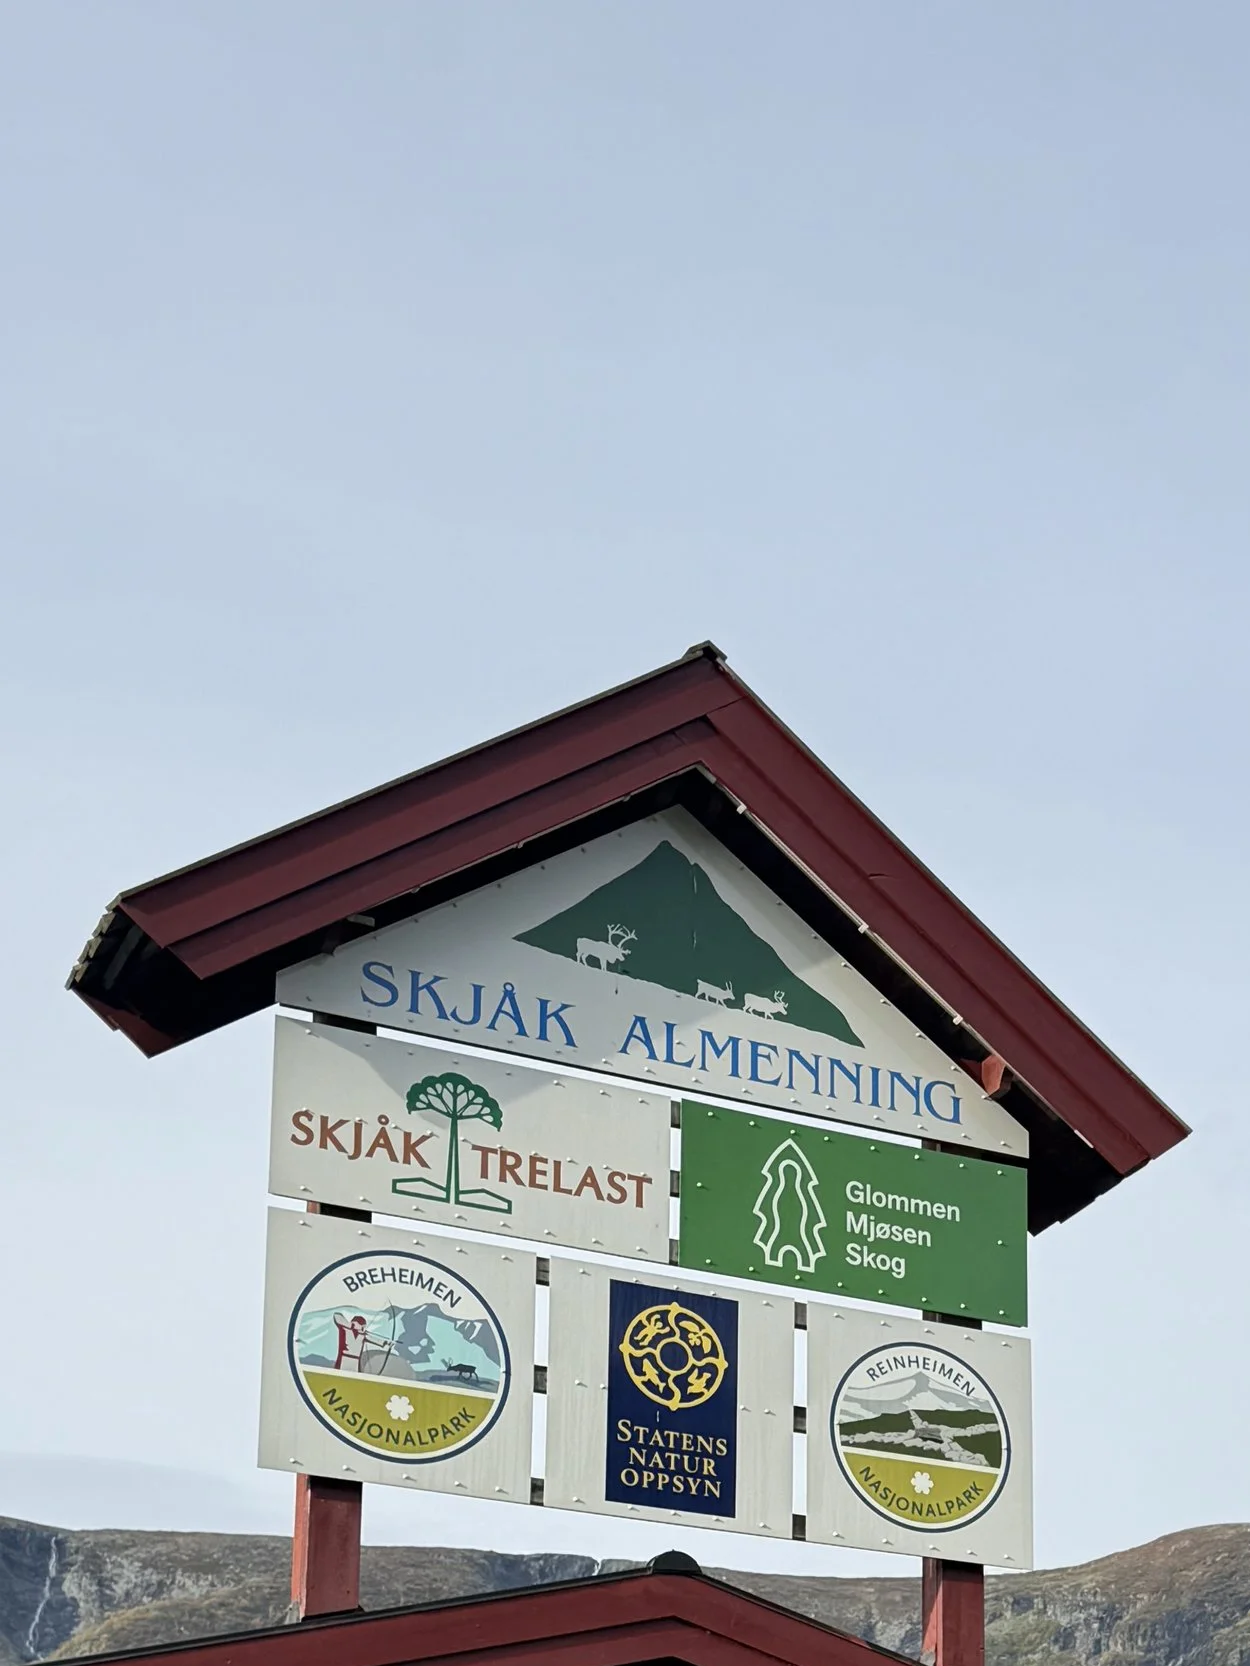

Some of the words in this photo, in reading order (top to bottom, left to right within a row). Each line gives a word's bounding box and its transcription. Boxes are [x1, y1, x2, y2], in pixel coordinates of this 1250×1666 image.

[360, 960, 578, 1048] SKJÅK
[617, 1015, 963, 1126] ALMENNING
[290, 1109, 432, 1168] SKJÅK
[471, 1145, 653, 1209] TRELAST
[845, 1180, 961, 1223] Glommen
[845, 1213, 932, 1248] Mjøsen
[845, 1242, 906, 1279] Skog
[343, 1266, 462, 1309] BREHEIMEN
[866, 1355, 976, 1397] REINHEIMEN
[322, 1387, 476, 1447] NASJONALPARK
[616, 1418, 728, 1457] STATENS
[628, 1446, 718, 1477] NATUR
[620, 1468, 721, 1499] OPPSYN
[859, 1466, 984, 1518] NASJONALPARK
